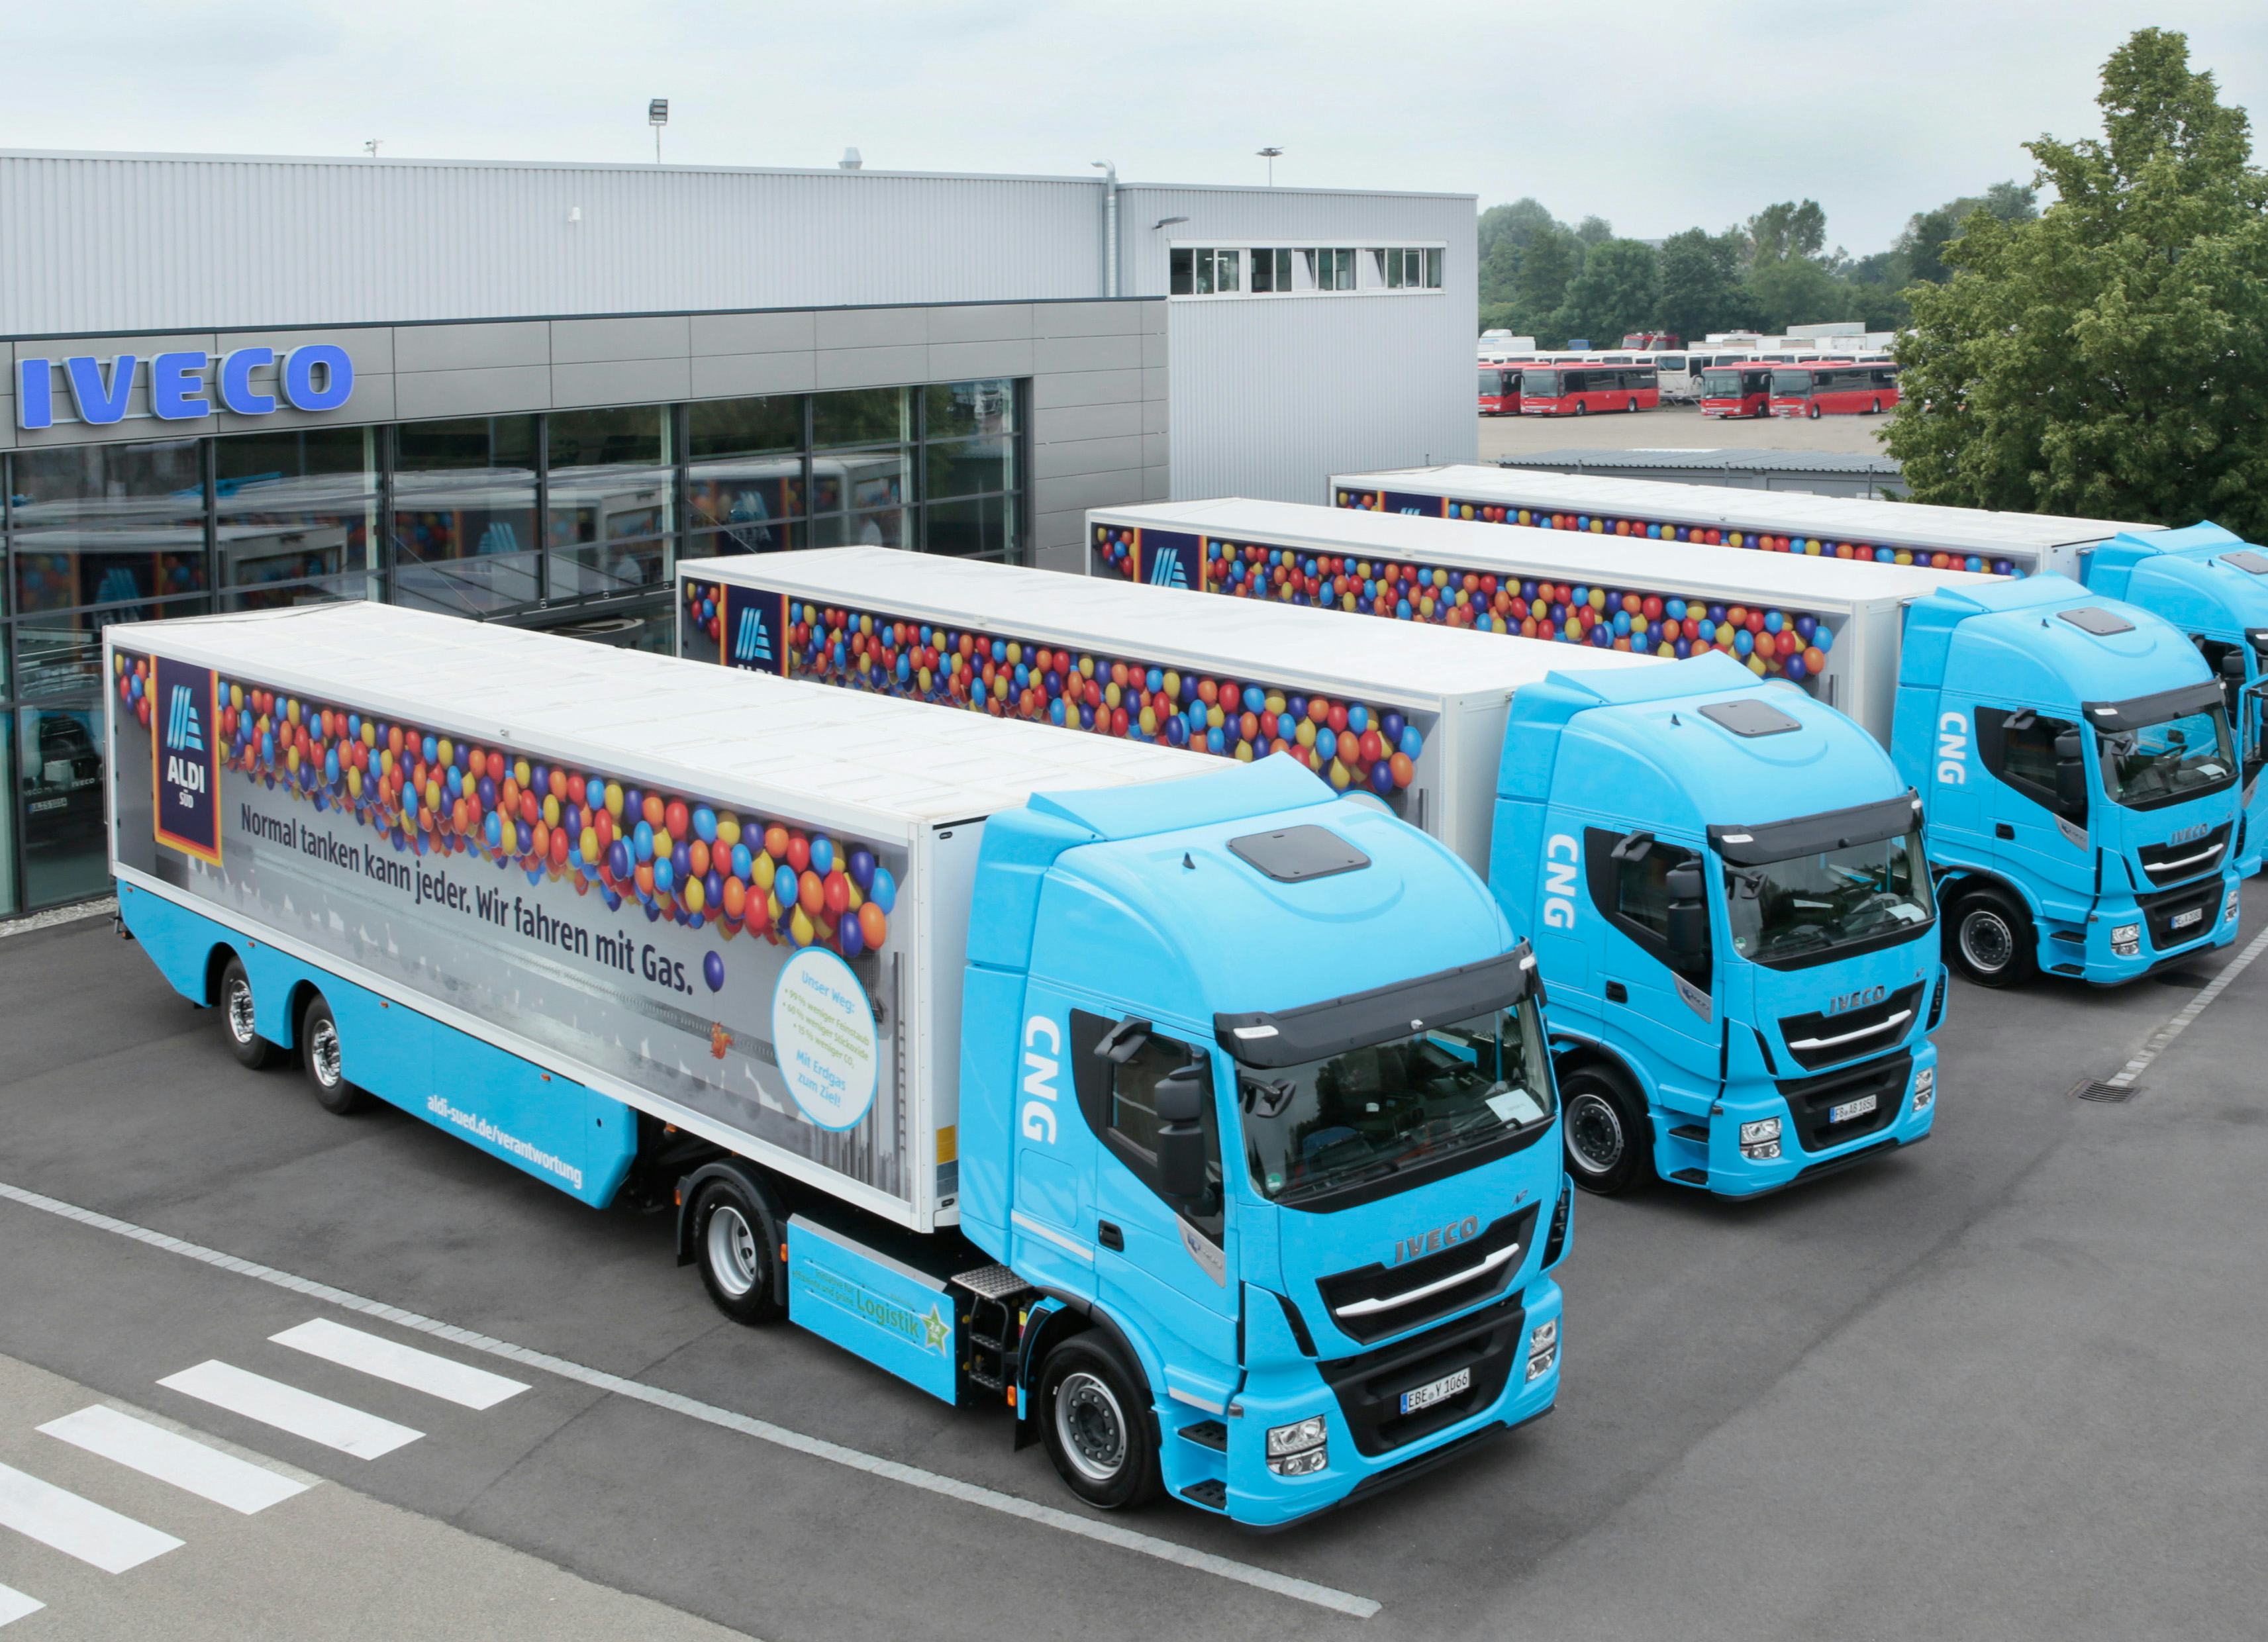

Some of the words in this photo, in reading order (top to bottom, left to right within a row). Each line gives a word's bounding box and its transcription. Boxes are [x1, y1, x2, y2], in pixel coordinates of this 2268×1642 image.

[17, 344, 354, 430] IVECO
[1938, 712, 1967, 785] CNG
[167, 755, 205, 794] ALDI
[178, 789, 194, 808] SÜD
[241, 802, 297, 849] Normal
[301, 824, 360, 873] tanken
[365, 844, 411, 892] kann
[415, 860, 471, 914] jeder.
[475, 885, 509, 927] Wir
[515, 896, 589, 957] fahren
[596, 930, 635, 975] mit
[642, 943, 693, 996] Gas.
[1544, 834, 1579, 929] CNG
[801, 970, 829, 996] Unser
[831, 988, 856, 1014] Weg:
[807, 1002, 836, 1023] weniger
[1829, 985, 1885, 1014] IVECO
[805, 1016, 833, 1038] weniger
[815, 1038, 843, 1059] weniger
[797, 1049, 811, 1069] Mit
[813, 1059, 846, 1091] Erdgas
[798, 1073, 818, 1092] zum
[820, 1085, 842, 1108] Ziel!
[1022, 1015, 1060, 1145] CNG
[427, 1094, 583, 1190] aldi-sued.de/verantwortung
[1395, 1215, 1479, 1263] IVECO
[856, 1288, 920, 1338] Logistik
[1408, 1388, 1427, 1408] EBE
[1436, 1382, 1442, 1397] Y
[1444, 1372, 1468, 1394] 1066
